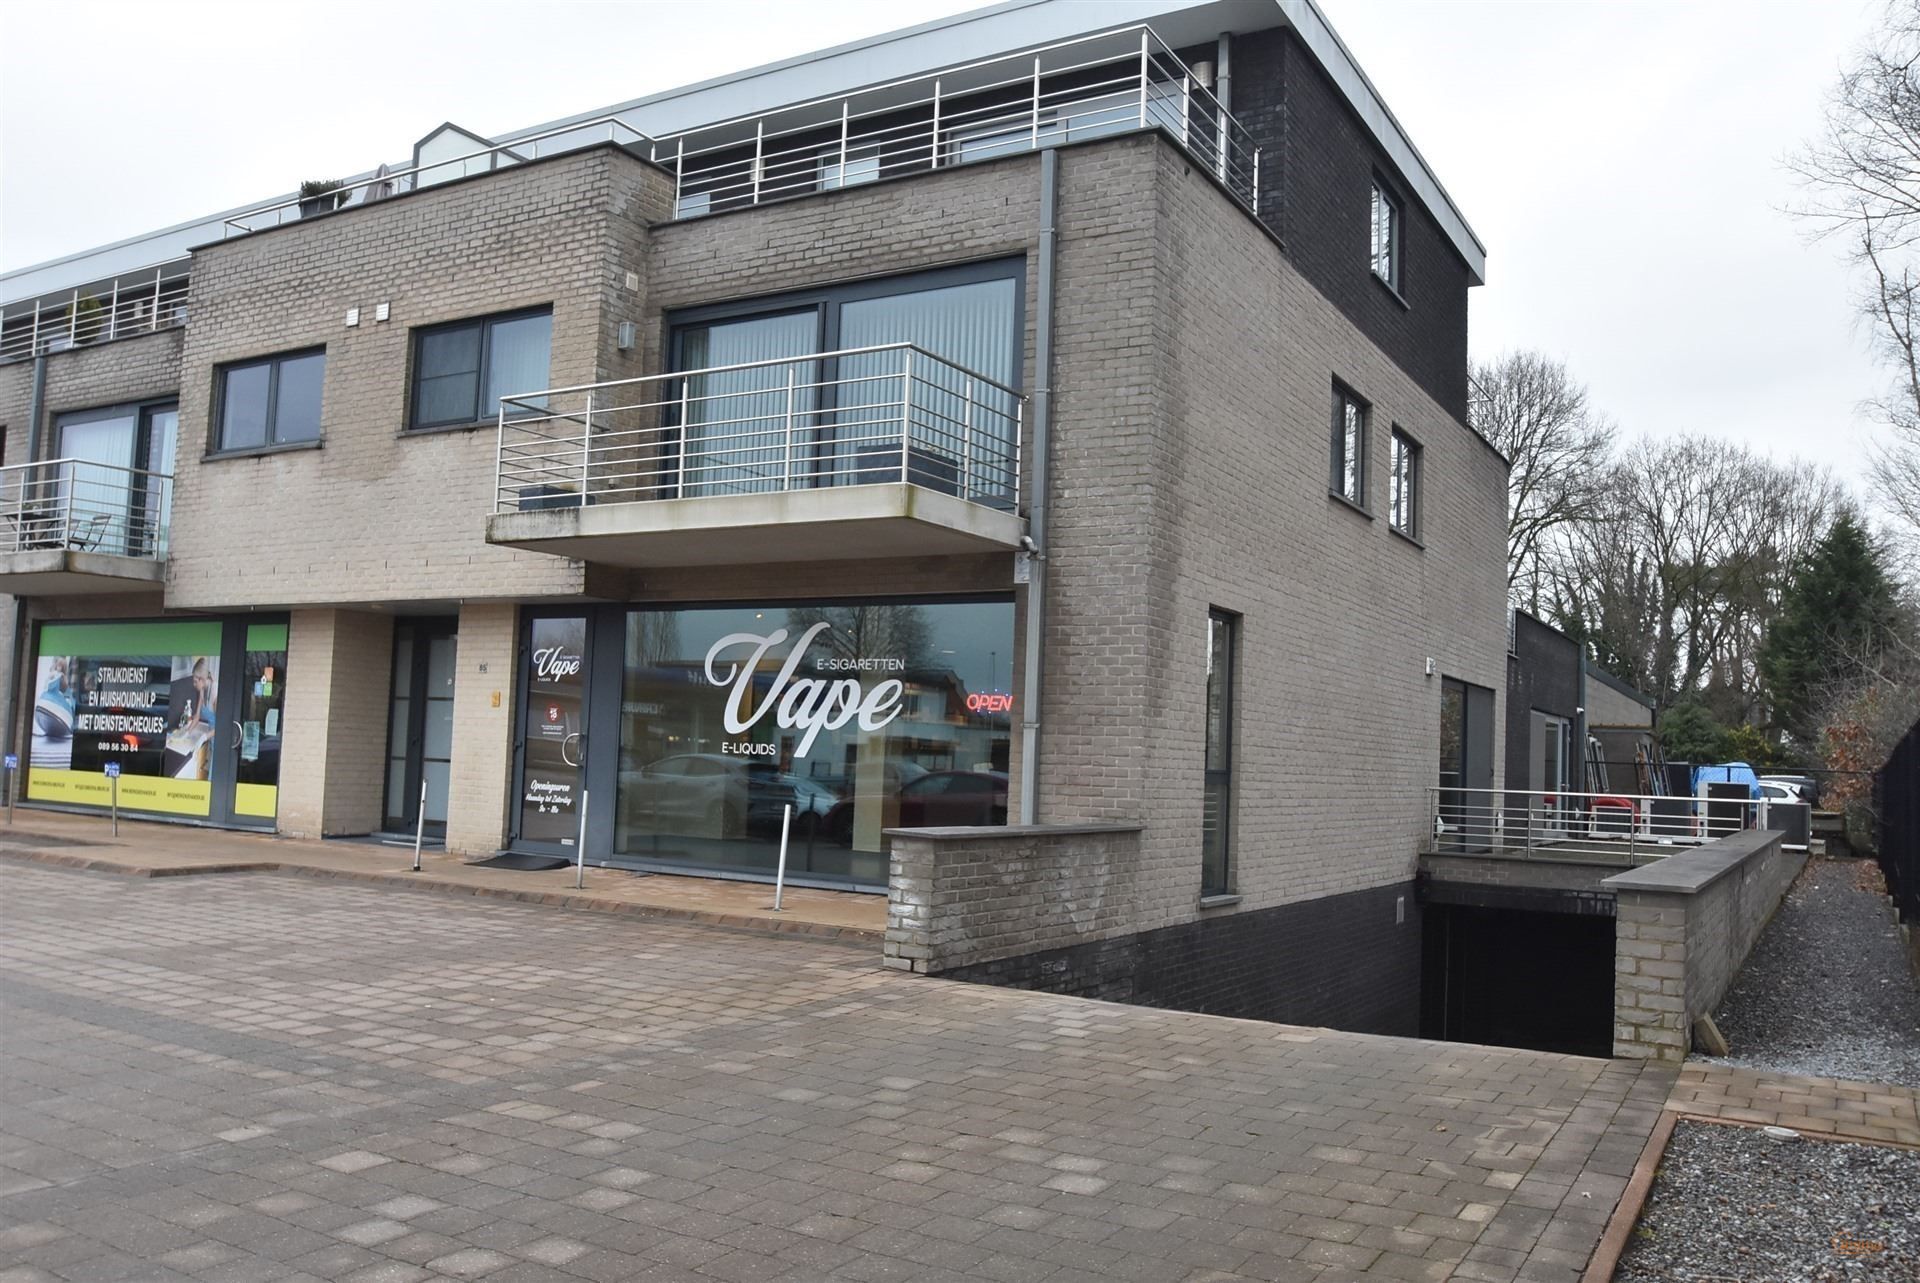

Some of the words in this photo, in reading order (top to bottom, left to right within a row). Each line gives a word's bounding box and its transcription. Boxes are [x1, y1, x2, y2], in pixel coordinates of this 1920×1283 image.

[533, 646, 580, 682] Vape
[817, 658, 905, 671] E-SIGARETTEN
[98, 667, 149, 683] STRIJKDIENST
[704, 622, 904, 758] Vape
[88, 691, 99, 707] EN
[100, 691, 156, 708] HUISHOUDHULP
[966, 693, 1013, 712] OPEN
[78, 714, 93, 730] MET
[93, 714, 164, 733] DIENSTENCHEQUES
[120, 743, 129, 752] 30
[722, 741, 776, 756] E-LIQUIDS
